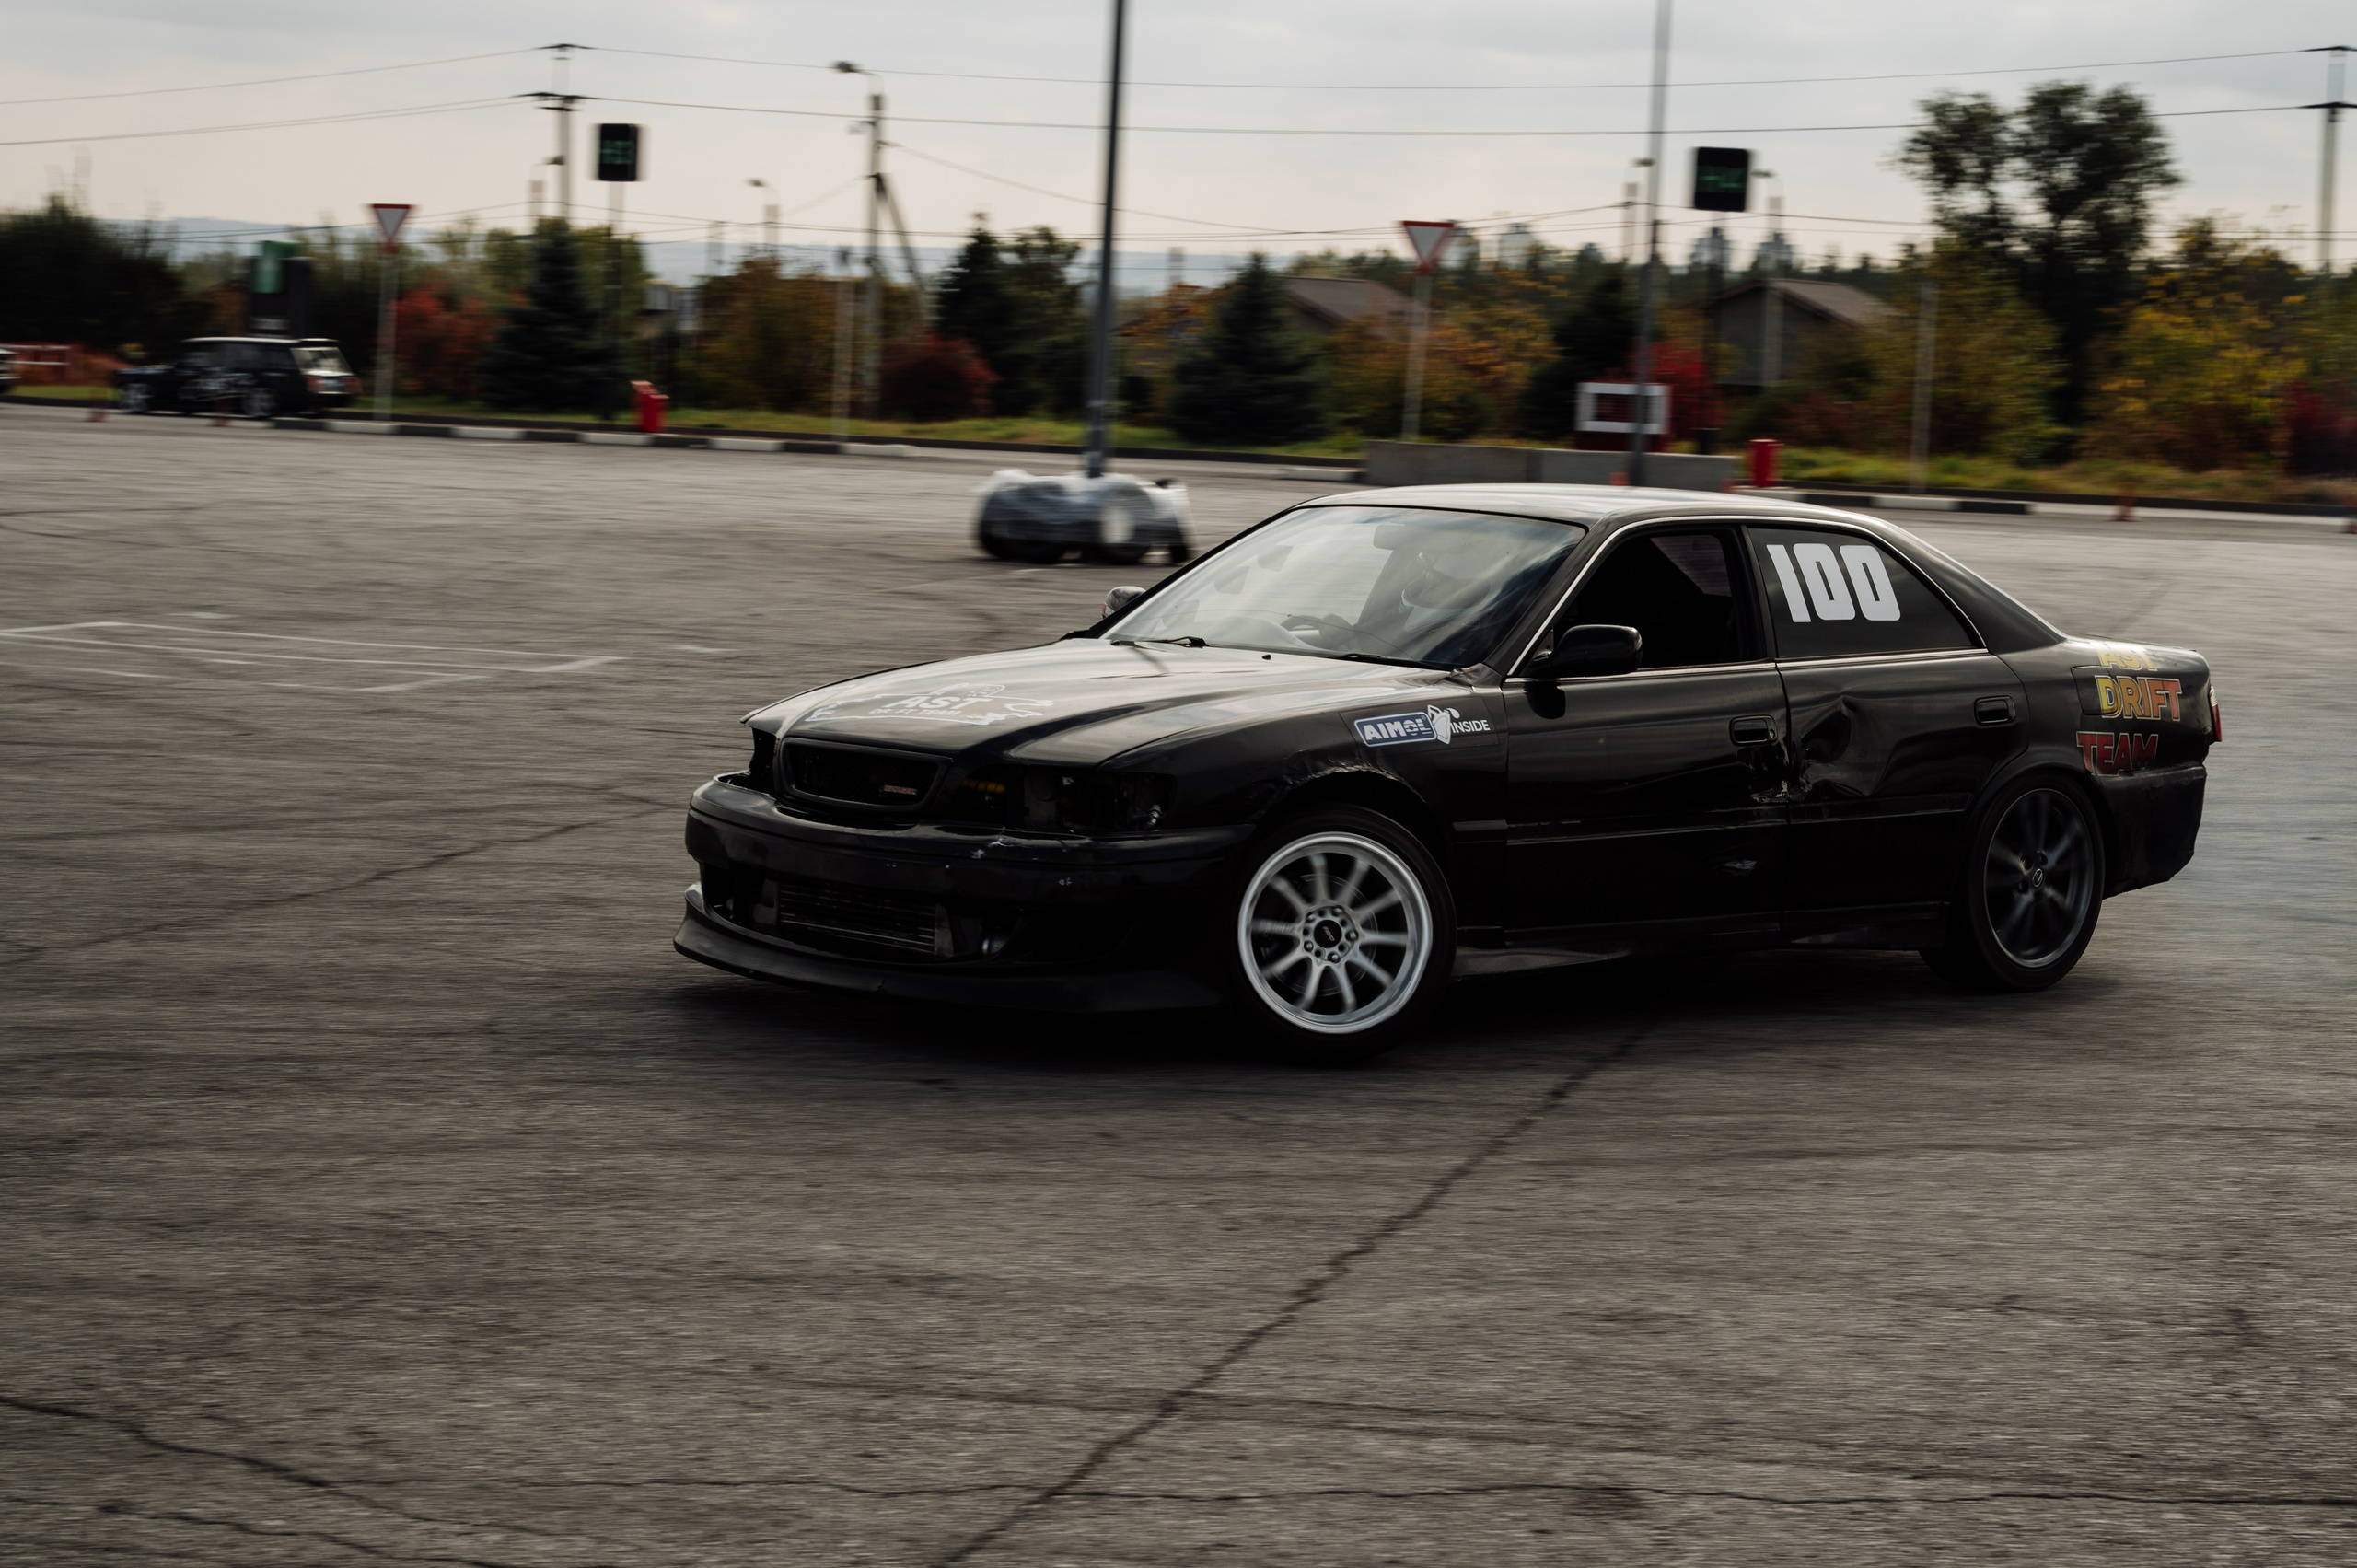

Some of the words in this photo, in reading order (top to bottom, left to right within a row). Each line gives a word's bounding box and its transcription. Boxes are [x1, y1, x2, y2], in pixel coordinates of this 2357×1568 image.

[1766, 543, 1901, 622] 100
[2096, 643, 2158, 671] AST
[882, 696, 994, 709] AST
[2094, 675, 2182, 722] DRIFT
[1363, 718, 1433, 740] AIMOL
[1450, 719, 1491, 734] INSIDE
[2076, 731, 2158, 776] TEAM
